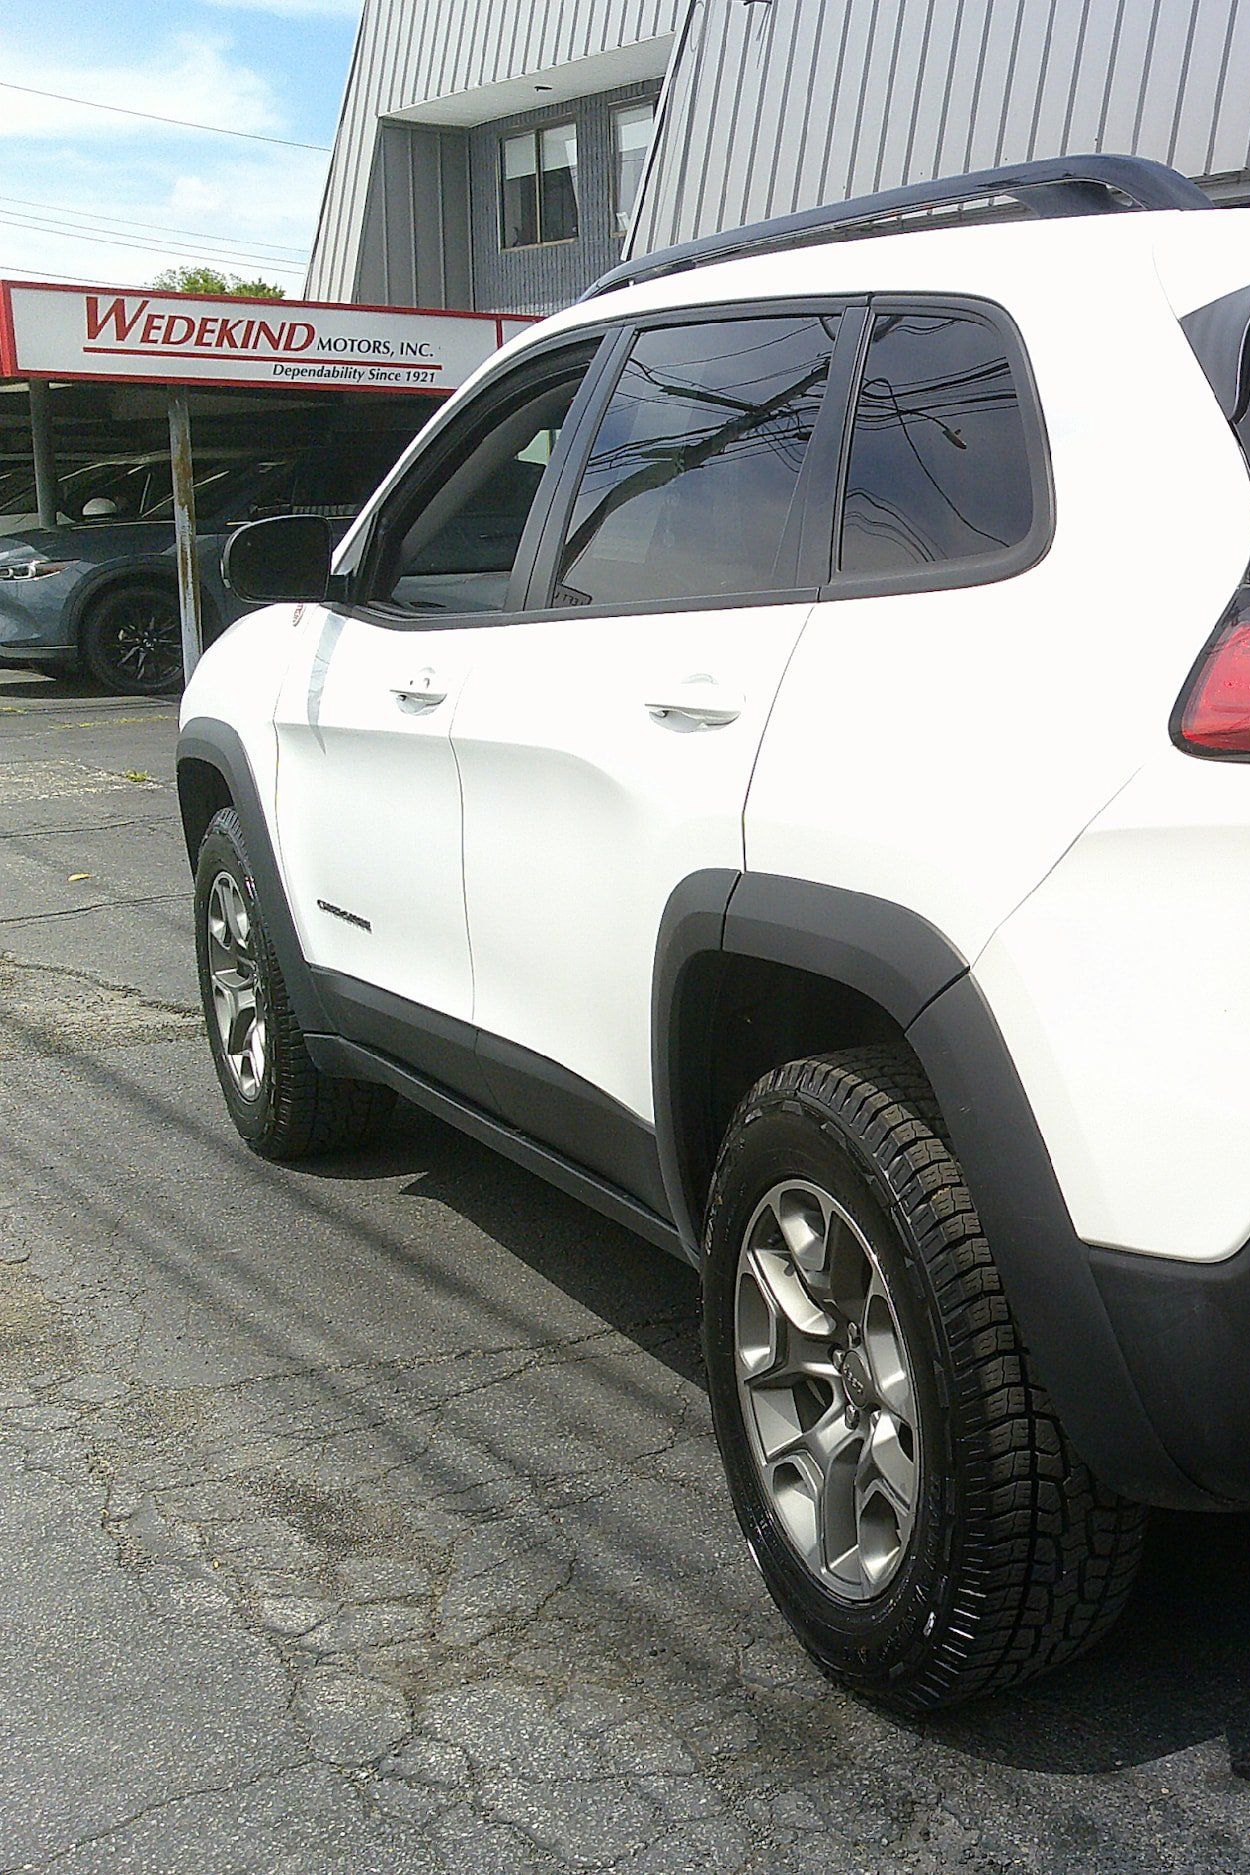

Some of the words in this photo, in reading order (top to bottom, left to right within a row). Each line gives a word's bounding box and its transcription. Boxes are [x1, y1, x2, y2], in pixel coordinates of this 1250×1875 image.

[85, 296, 316, 352] WEDEKIND
[317, 337, 395, 358] MOTORS,
[400, 342, 434, 357] INC.
[272, 364, 364, 382] Dependability
[368, 368, 401, 381] Since
[405, 371, 435, 382] 1921
